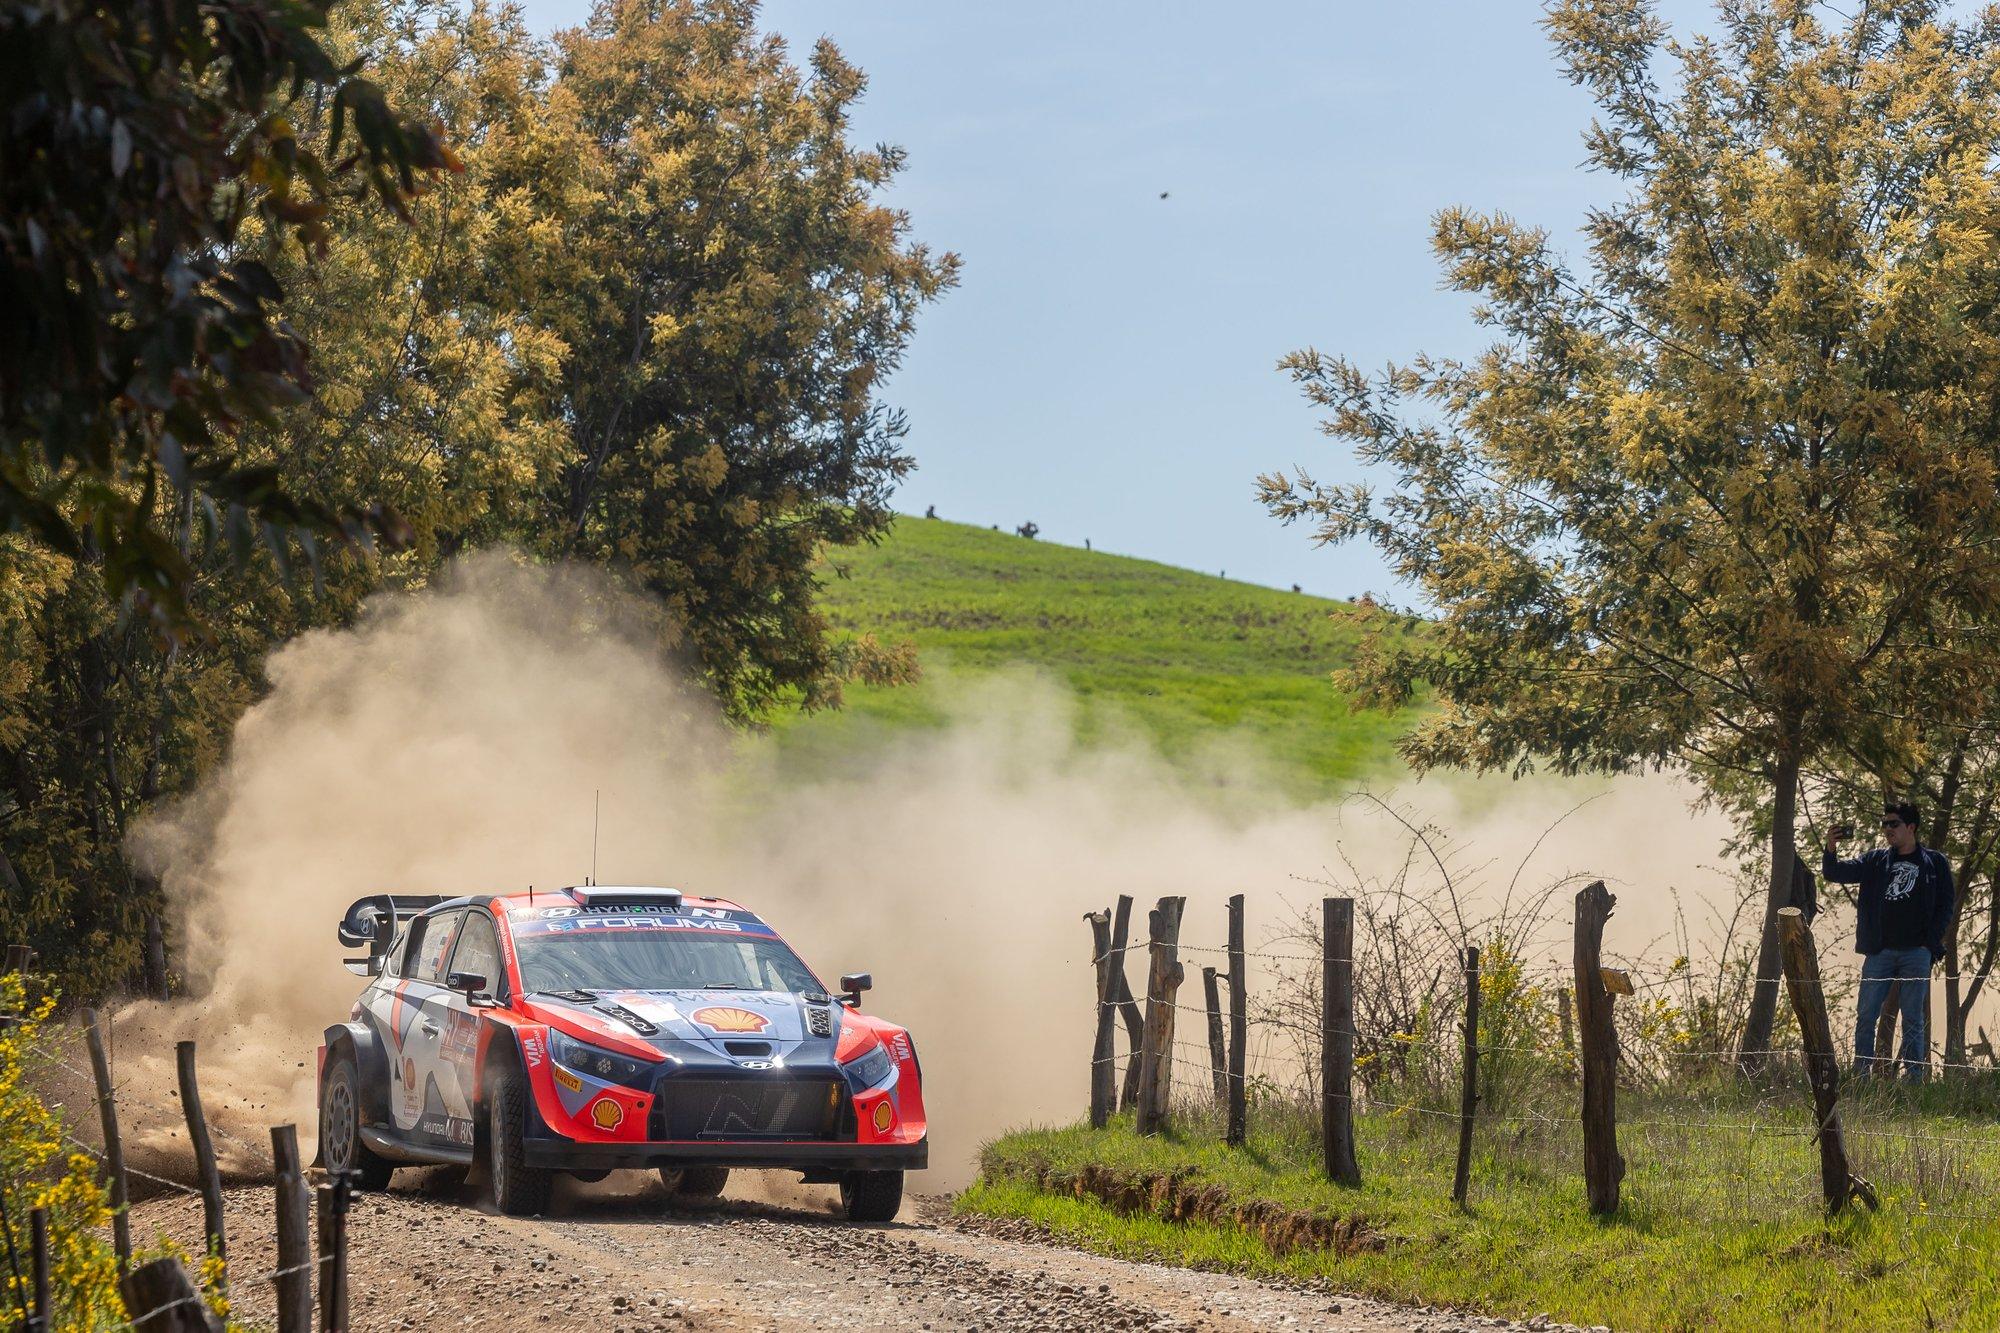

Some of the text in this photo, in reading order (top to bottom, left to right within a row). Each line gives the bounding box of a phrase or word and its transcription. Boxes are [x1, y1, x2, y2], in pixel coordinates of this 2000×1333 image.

[576, 917, 742, 932] FORUM8
[523, 1038, 541, 1068] WIA
[555, 1068, 579, 1090] PIRELLI
